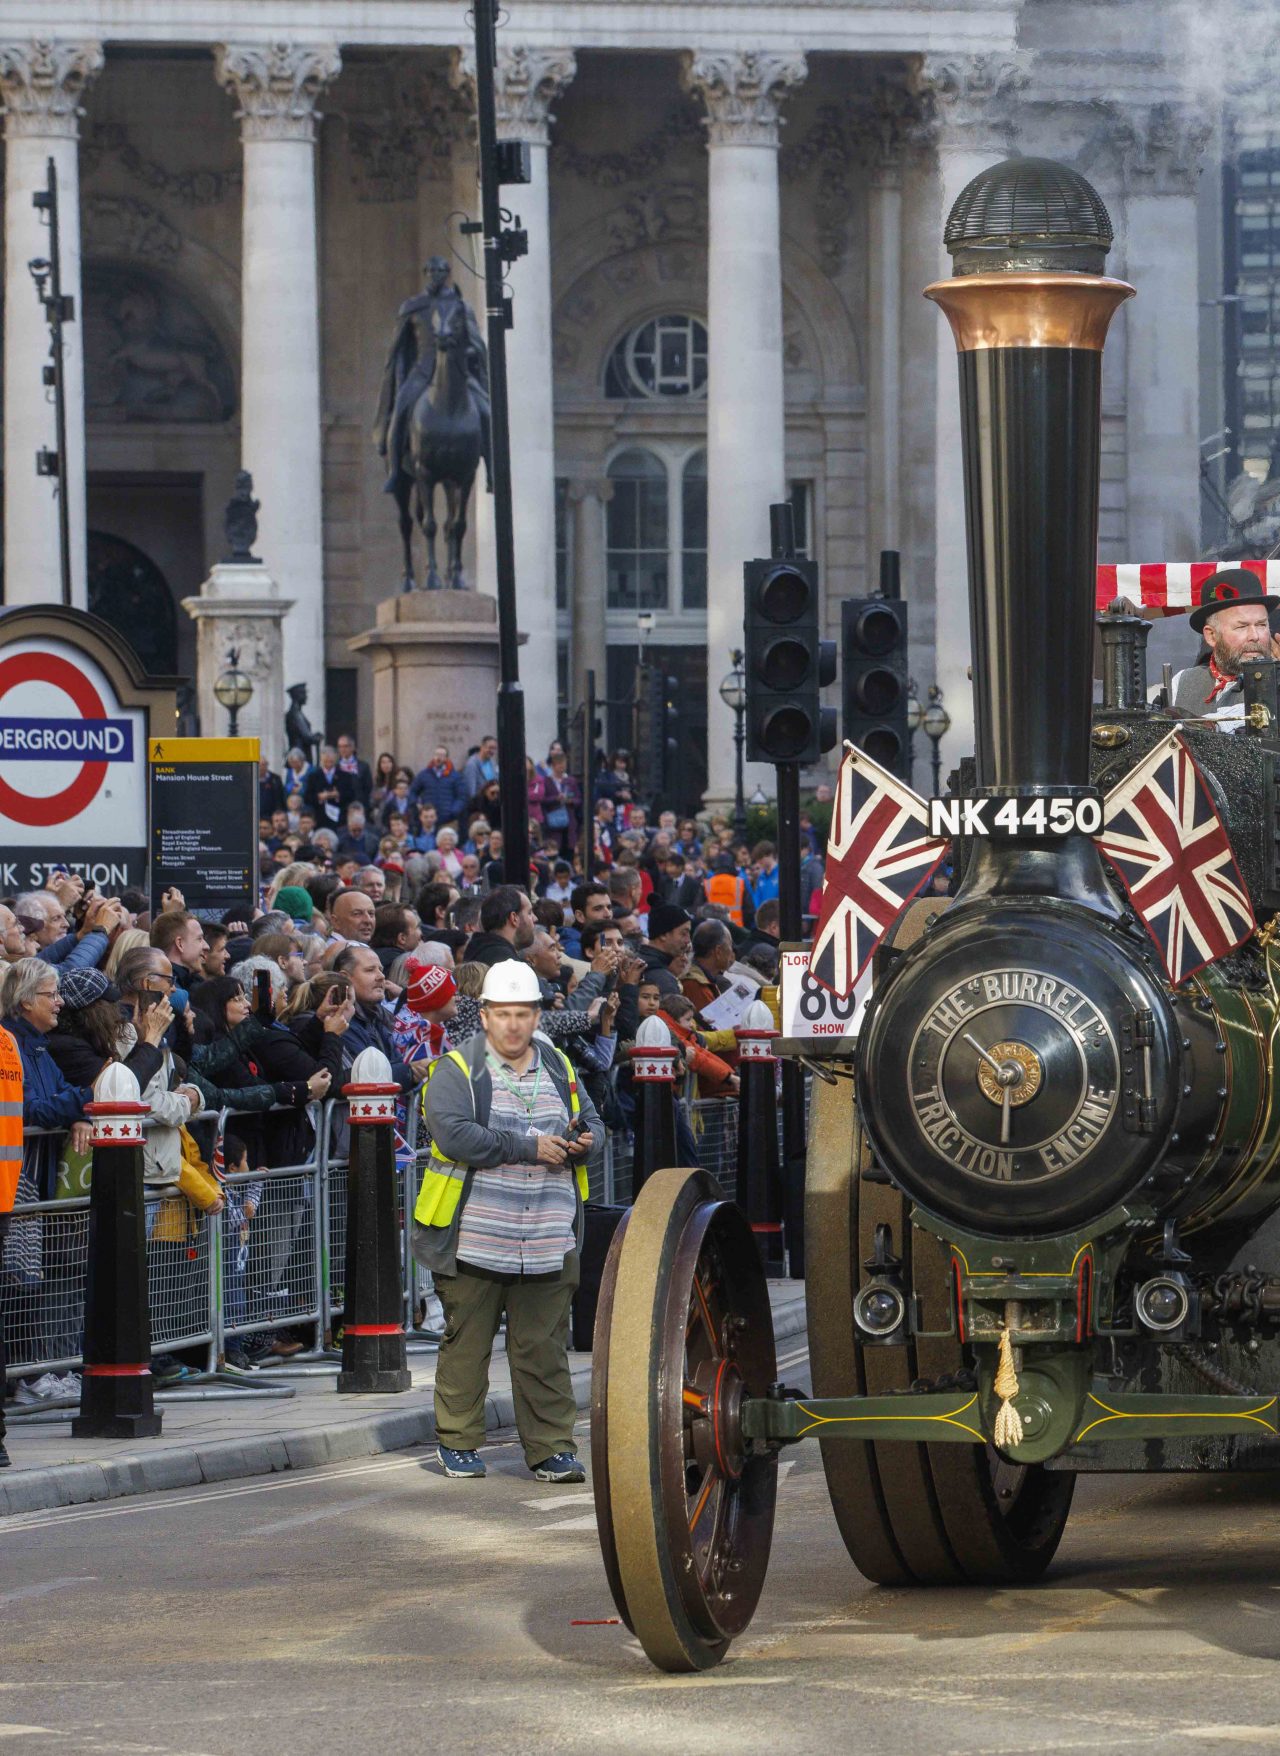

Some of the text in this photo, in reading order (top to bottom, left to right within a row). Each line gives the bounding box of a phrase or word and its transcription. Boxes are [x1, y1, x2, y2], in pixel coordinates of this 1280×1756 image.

[0, 727, 124, 754] ERGROUND
[932, 798, 1102, 836] NK 4450
[30, 863, 128, 886] STTION
[788, 956, 810, 965] LOR
[420, 968, 446, 994] ENGL
[924, 991, 974, 1038] THE
[812, 1024, 844, 1034] SHOW
[914, 1085, 1116, 1180] TRACTION ENGINE
